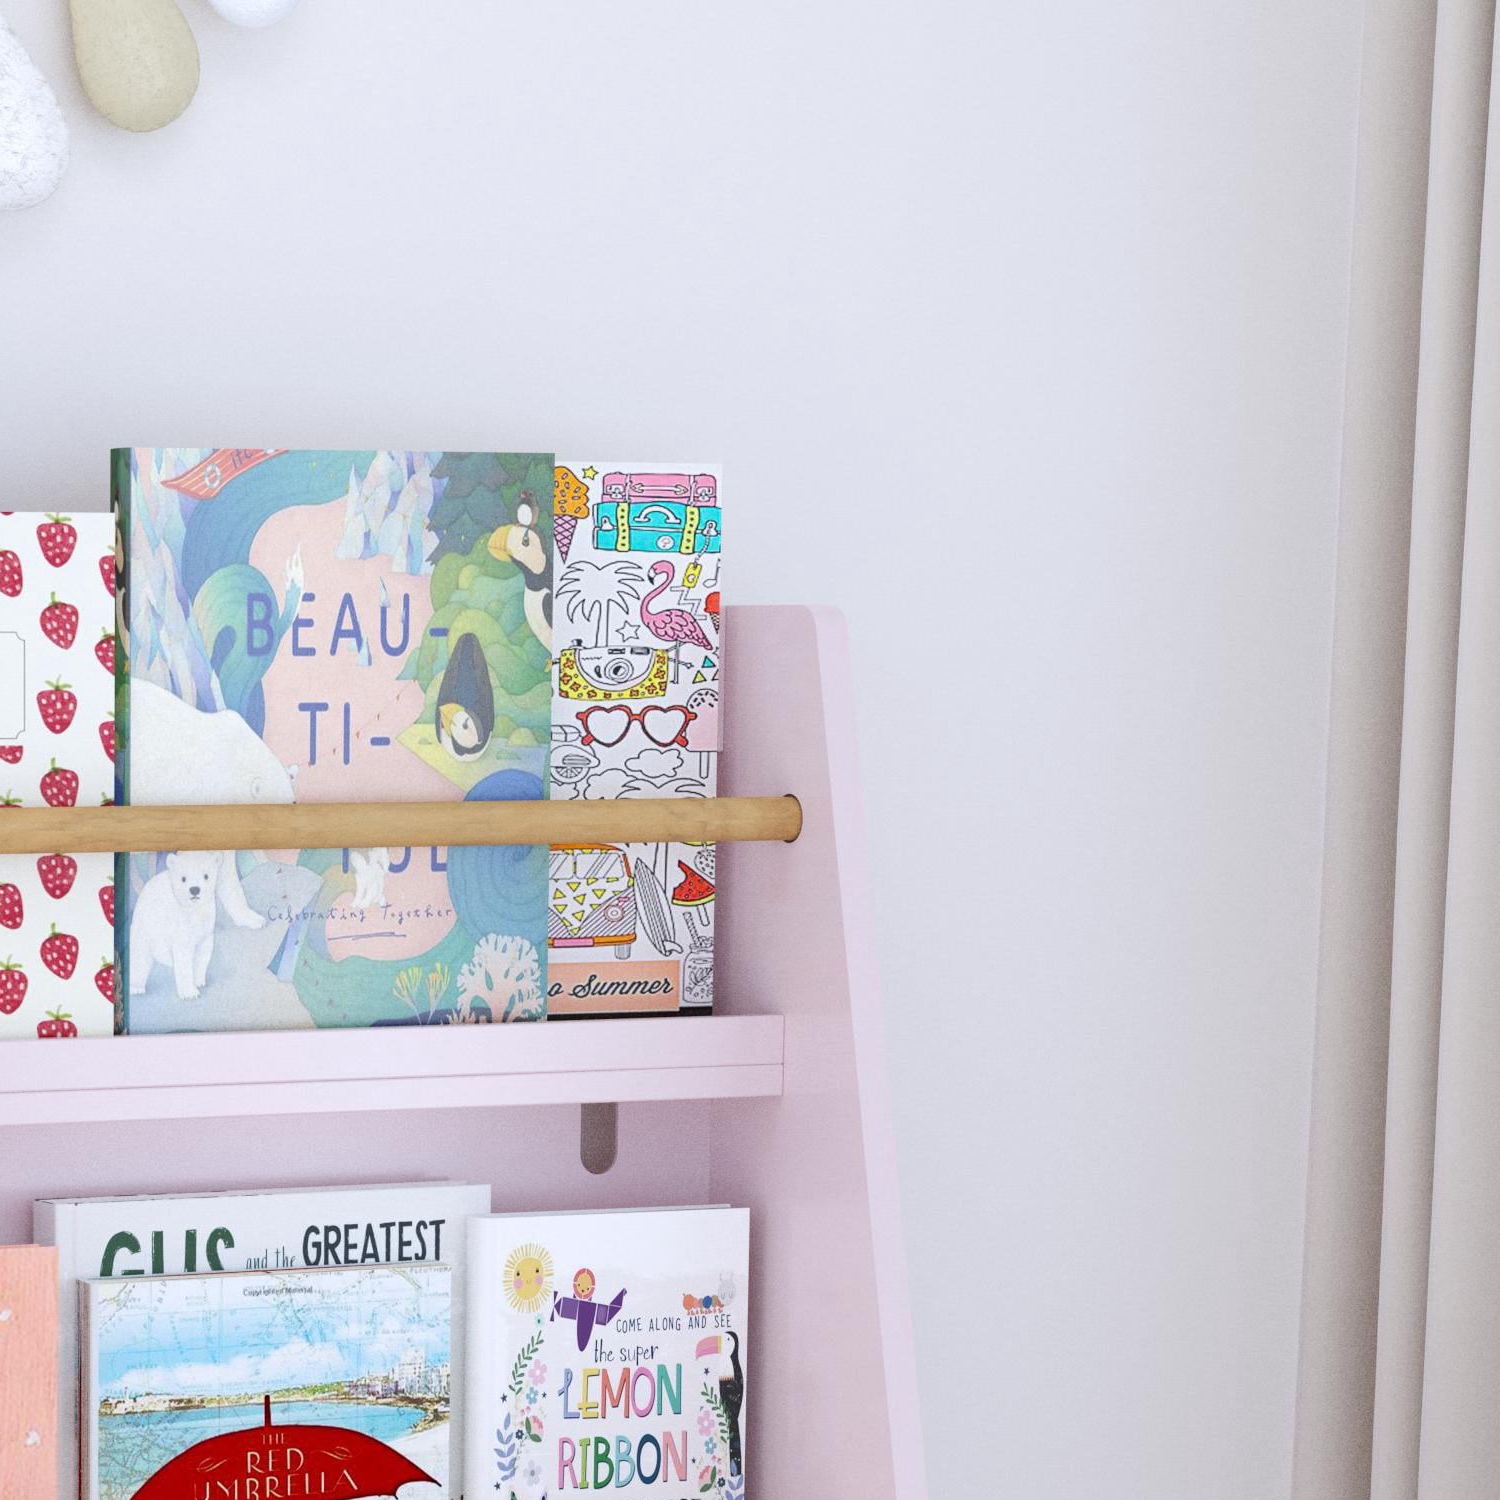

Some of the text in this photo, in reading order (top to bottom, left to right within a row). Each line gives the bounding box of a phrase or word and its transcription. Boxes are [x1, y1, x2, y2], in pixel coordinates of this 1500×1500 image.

[298, 702, 391, 766] TI-
[381, 903, 454, 925] Together
[567, 973, 674, 999] Summer
[245, 1248, 268, 1270] and
[275, 1245, 296, 1268] the
[302, 1219, 446, 1267] GREATEST
[616, 1313, 732, 1334] COME ALONG AND SEE
[594, 1338, 659, 1366] the super
[558, 1363, 682, 1419] LEMON
[262, 1432, 285, 1446] THE
[246, 1447, 305, 1474] RED
[558, 1430, 687, 1489] RIBBON
